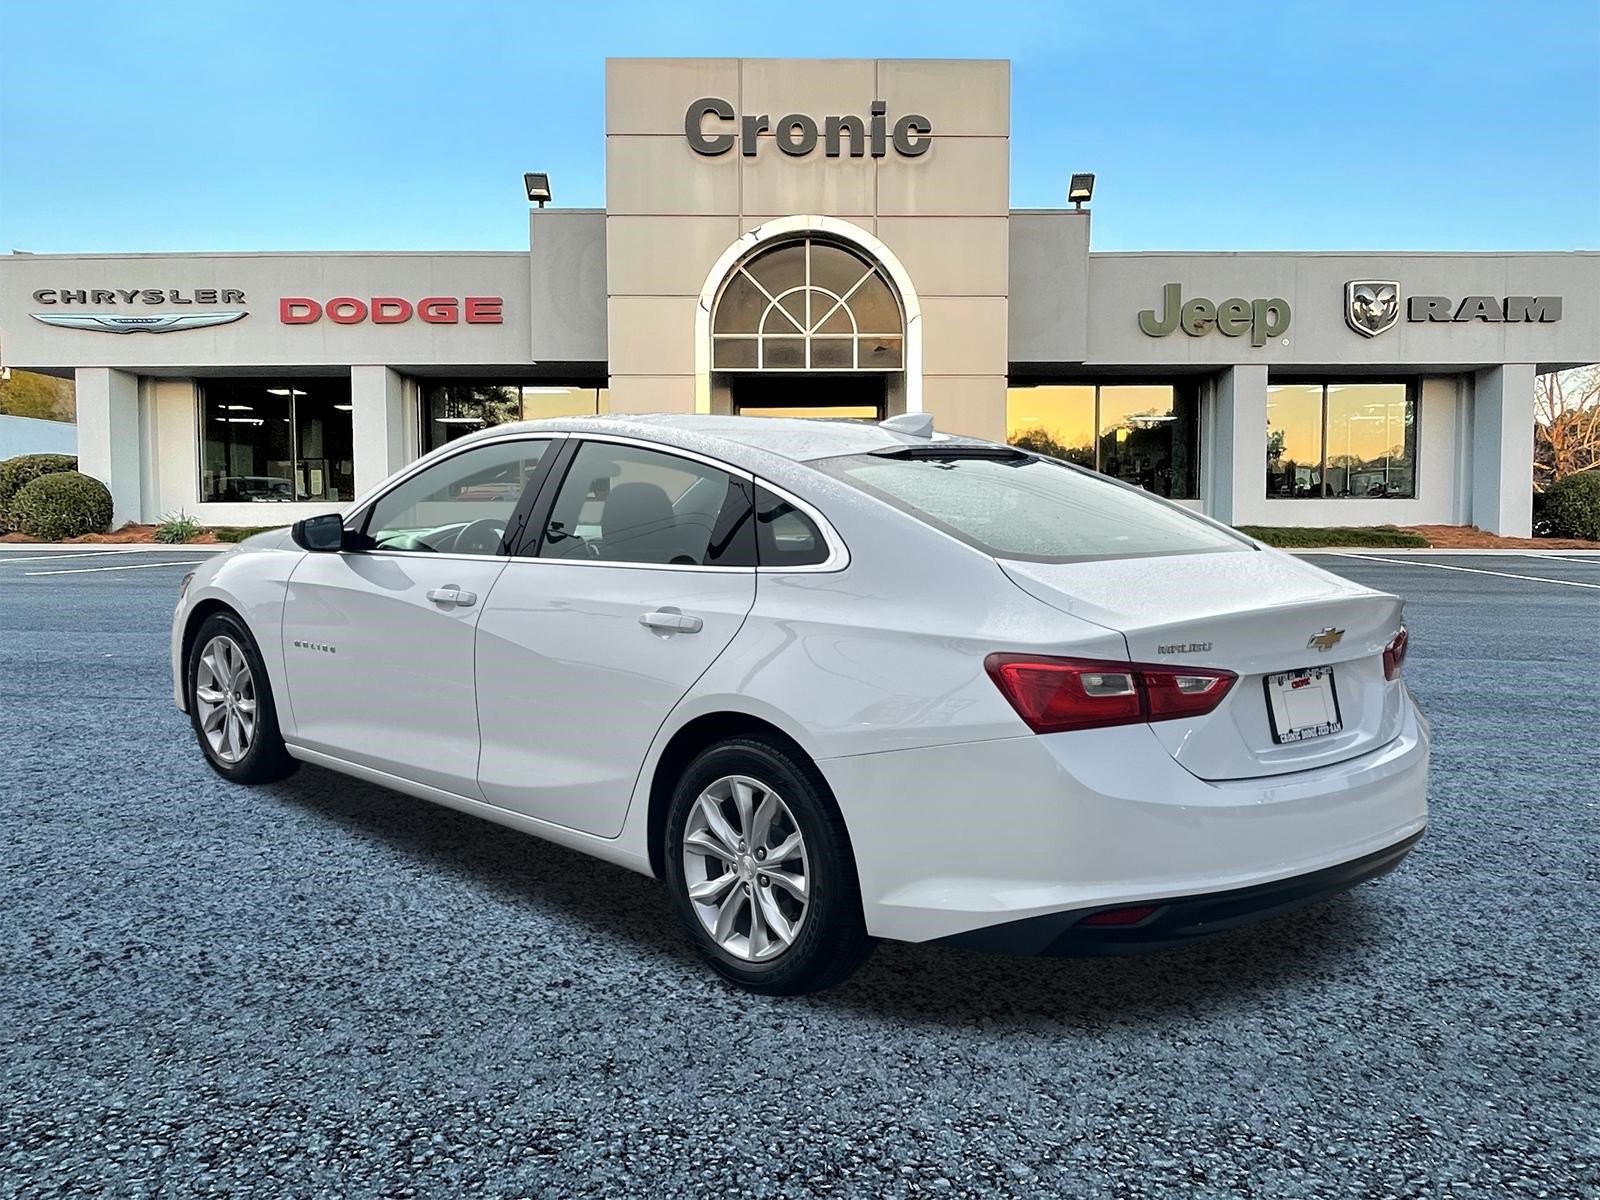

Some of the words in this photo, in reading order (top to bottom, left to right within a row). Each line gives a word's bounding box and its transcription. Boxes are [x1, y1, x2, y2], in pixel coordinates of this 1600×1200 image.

[685, 97, 932, 157] Cronic
[32, 289, 247, 305] CHRYSLER
[279, 297, 503, 324] DODGE
[1408, 296, 1563, 323] RAM
[1138, 283, 1292, 347] Jeep
[1157, 642, 1213, 655] MALIBU
